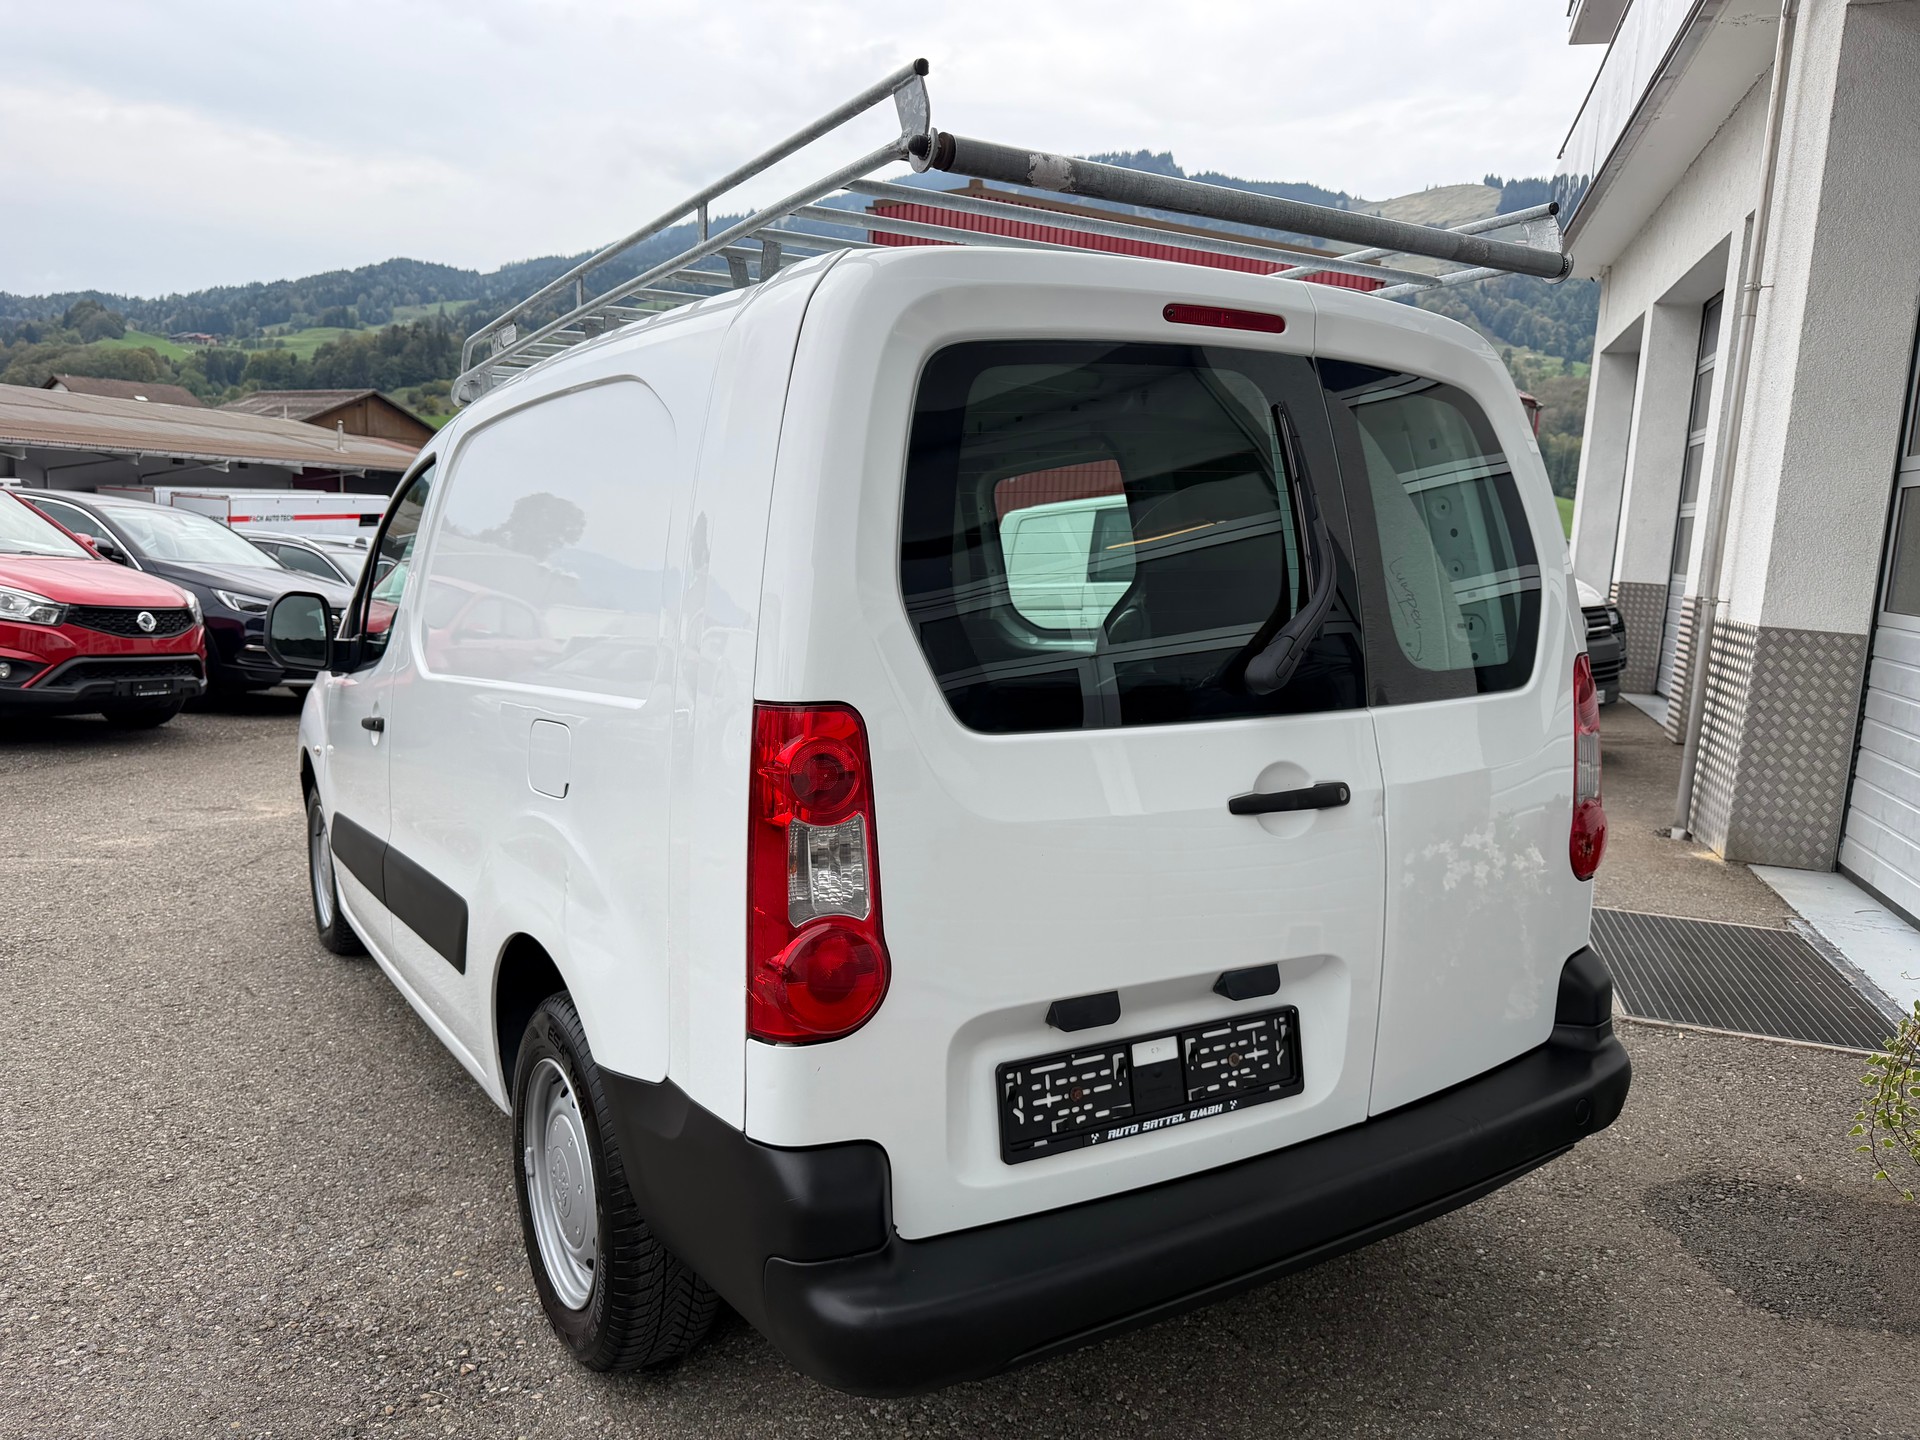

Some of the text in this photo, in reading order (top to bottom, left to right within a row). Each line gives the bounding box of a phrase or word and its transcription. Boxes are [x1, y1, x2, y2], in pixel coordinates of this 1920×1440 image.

[265, 514, 279, 522] AUTO
[1107, 1103, 1223, 1140] AUTO SATTEL GMBH
[595, 1250, 608, 1323] SUPERGRIP
